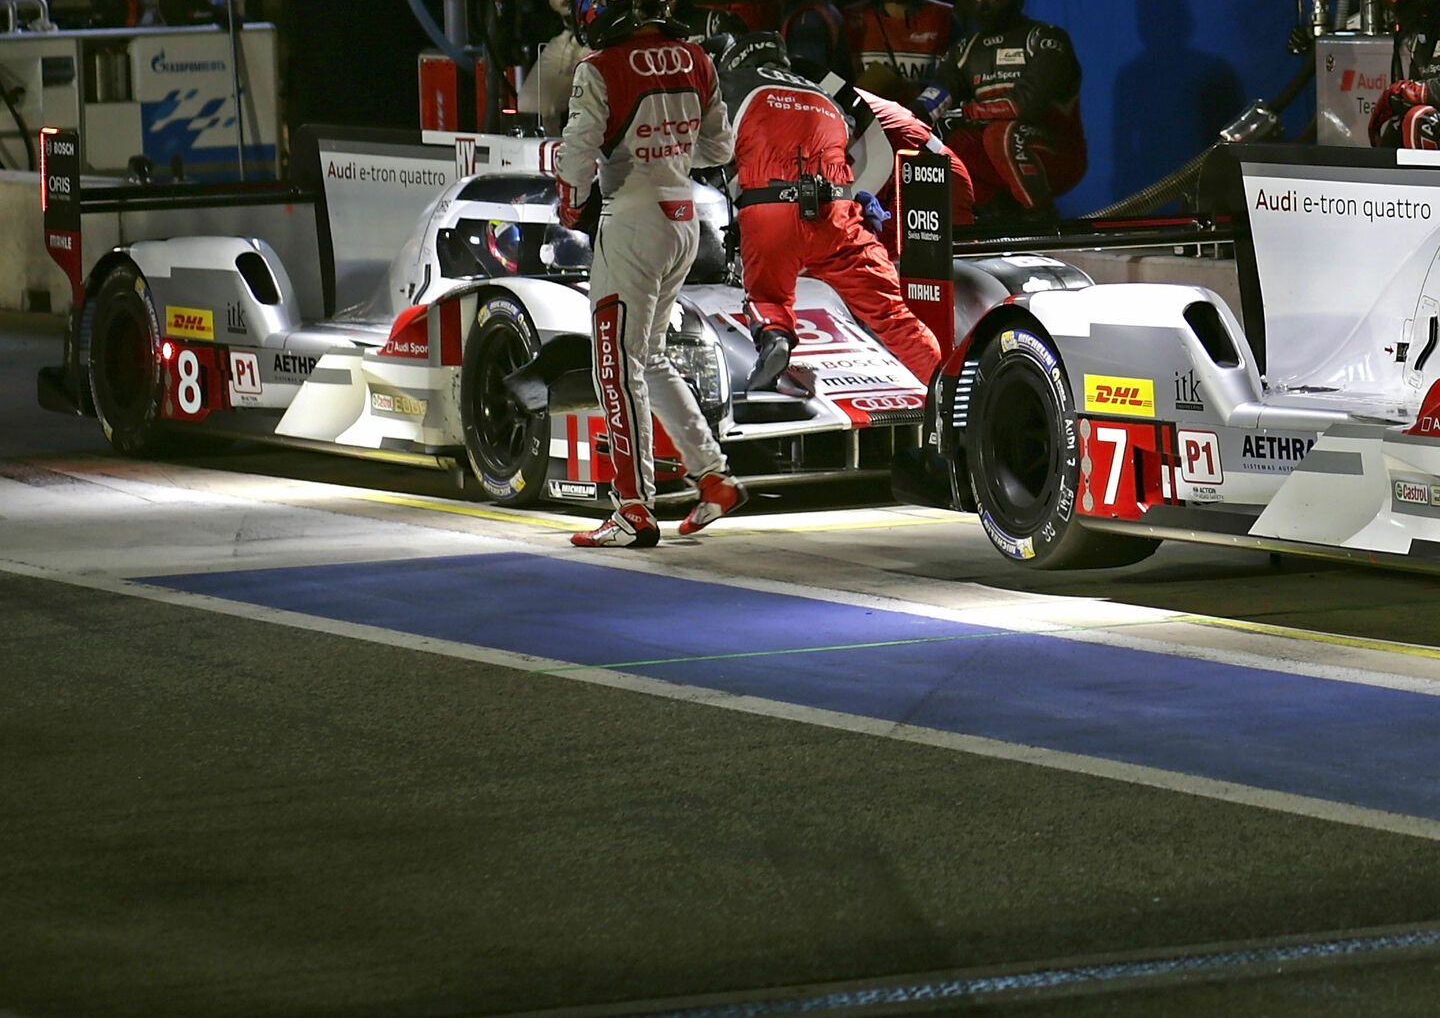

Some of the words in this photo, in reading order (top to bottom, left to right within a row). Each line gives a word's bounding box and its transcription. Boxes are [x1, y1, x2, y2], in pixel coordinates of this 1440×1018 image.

[1357, 73, 1387, 90] Audi
[767, 94, 796, 103] Audi
[768, 101, 790, 110] Top
[795, 103, 836, 119] Service
[53, 142, 75, 156] BOSCH
[455, 140, 476, 179] HY
[49, 175, 70, 194] ORIS
[327, 161, 356, 181] Audi
[359, 164, 397, 183] e-tron
[400, 168, 446, 188] quattro
[914, 166, 945, 183] BOSCH
[1255, 189, 1297, 212] Audi
[1303, 194, 1357, 216] e-tron
[1363, 198, 1431, 223] quattro
[907, 209, 939, 231] ORIS
[908, 283, 941, 302] MAHLE
[172, 314, 206, 332] DHL
[227, 301, 246, 328] itk
[796, 319, 834, 344] 8
[394, 342, 409, 352] Audi
[600, 321, 614, 379] Sport
[1018, 333, 1055, 366] MICHELIN
[235, 359, 256, 387] P1
[821, 359, 899, 370] BOSCH
[177, 349, 202, 415] 8
[821, 374, 900, 387] MAHLE
[1174, 370, 1204, 403] itk
[605, 384, 624, 428] Audi
[1095, 385, 1145, 407] DHL
[1064, 419, 1076, 450] AUDI
[1066, 457, 1076, 467] 7
[1095, 426, 1128, 505] 7
[1185, 440, 1215, 475] P1
[1243, 463, 1276, 471] SISTEMAS
[561, 482, 596, 496] MICHELIN
[1403, 483, 1427, 502] Castrol
[983, 519, 1017, 555] MICHELIN
